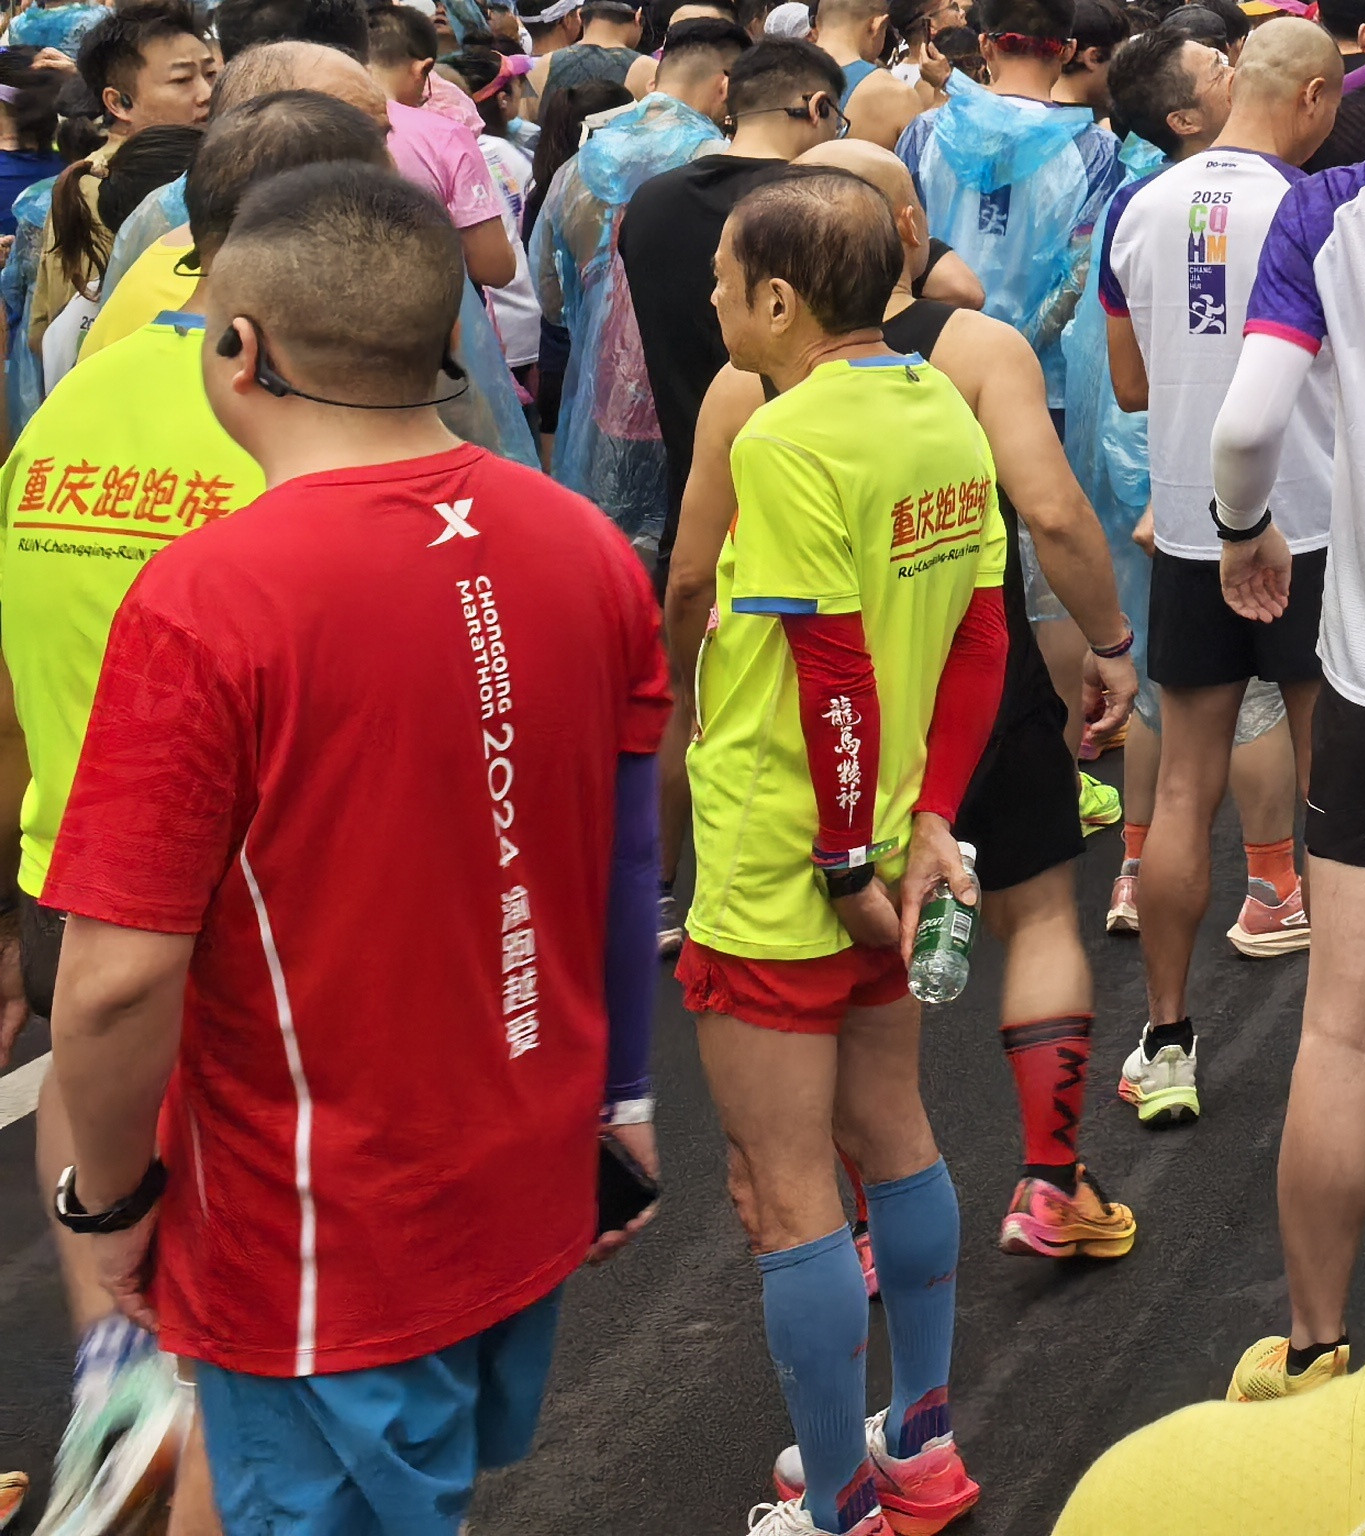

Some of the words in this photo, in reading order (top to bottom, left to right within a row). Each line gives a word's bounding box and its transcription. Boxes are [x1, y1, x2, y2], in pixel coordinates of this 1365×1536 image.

[1191, 191, 1233, 205] 2025
[1188, 204, 1229, 234] CQ
[1187, 230, 1227, 263] HM
[1189, 266, 1213, 275] CHANG
[1189, 274, 1201, 282] JIA
[1189, 282, 1202, 290] HUI
[17, 457, 236, 527] 重庆跑跑族
[821, 694, 863, 829] 龍馬精神
[483, 722, 520, 869] 2024
